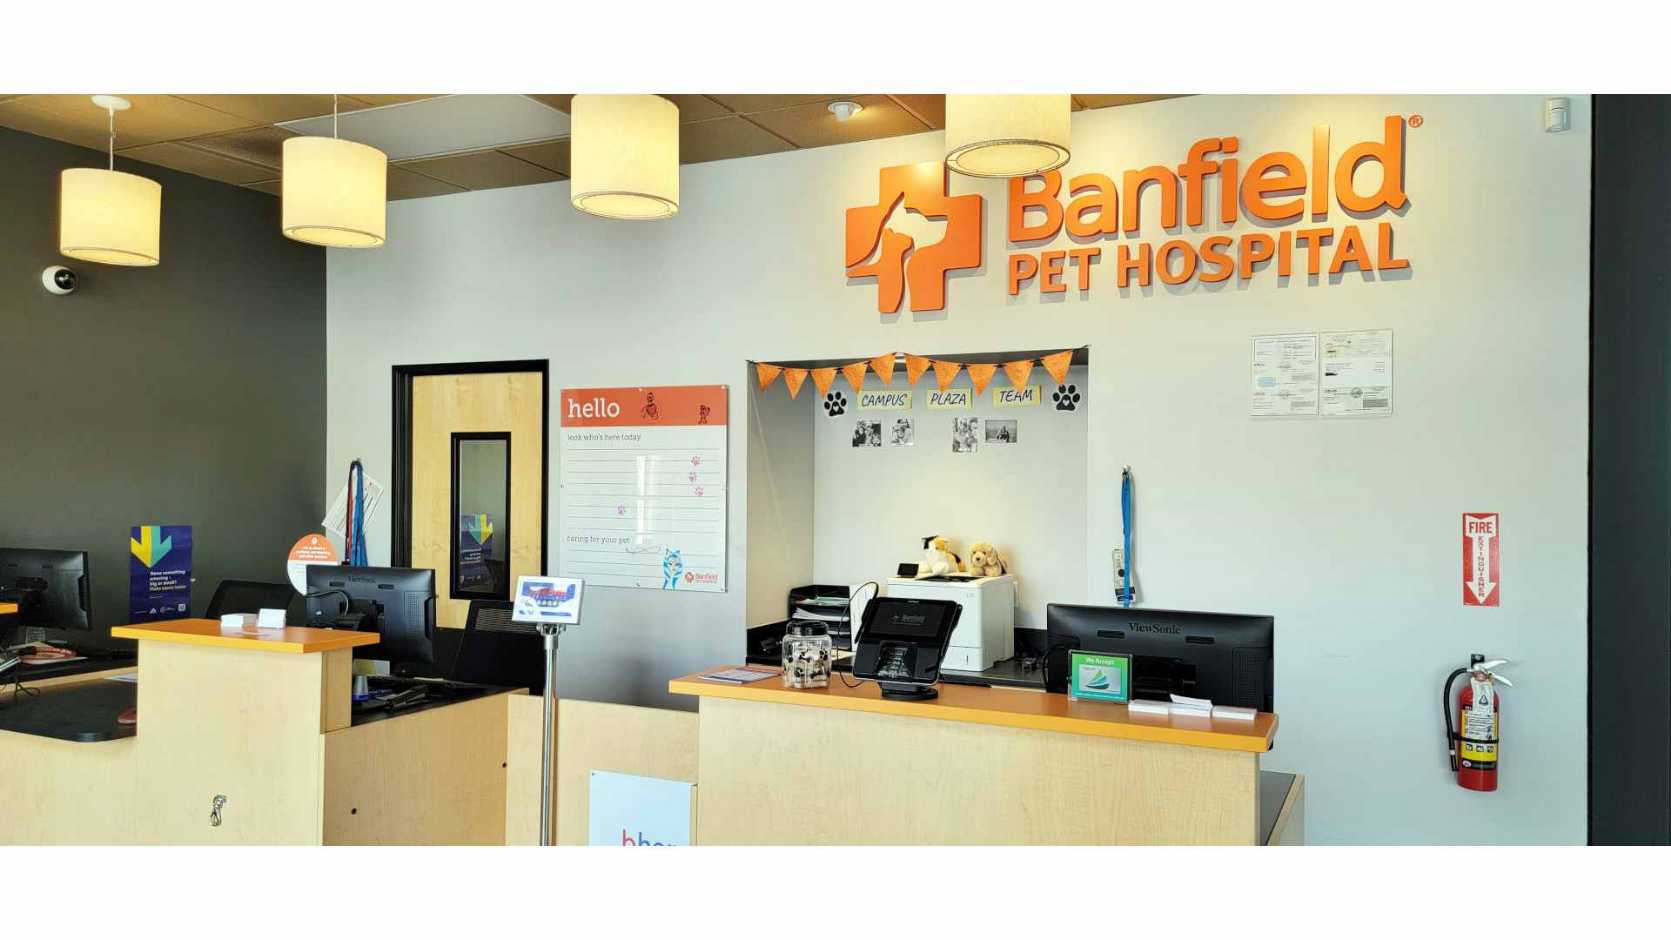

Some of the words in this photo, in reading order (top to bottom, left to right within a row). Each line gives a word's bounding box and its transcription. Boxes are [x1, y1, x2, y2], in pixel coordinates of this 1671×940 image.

[1008, 115, 1408, 242] Banfield
[1008, 247, 1102, 297] PET
[1116, 222, 1410, 289] HOSPITAL
[861, 393, 907, 407] CAMPUS
[929, 392, 967, 406] PLAZA
[999, 389, 1033, 403] TEAM
[567, 397, 621, 419] hello
[621, 433, 641, 442] today
[1468, 521, 1493, 534] FIRE
[601, 537, 617, 545] your
[1127, 622, 1182, 634] ViewSonic
